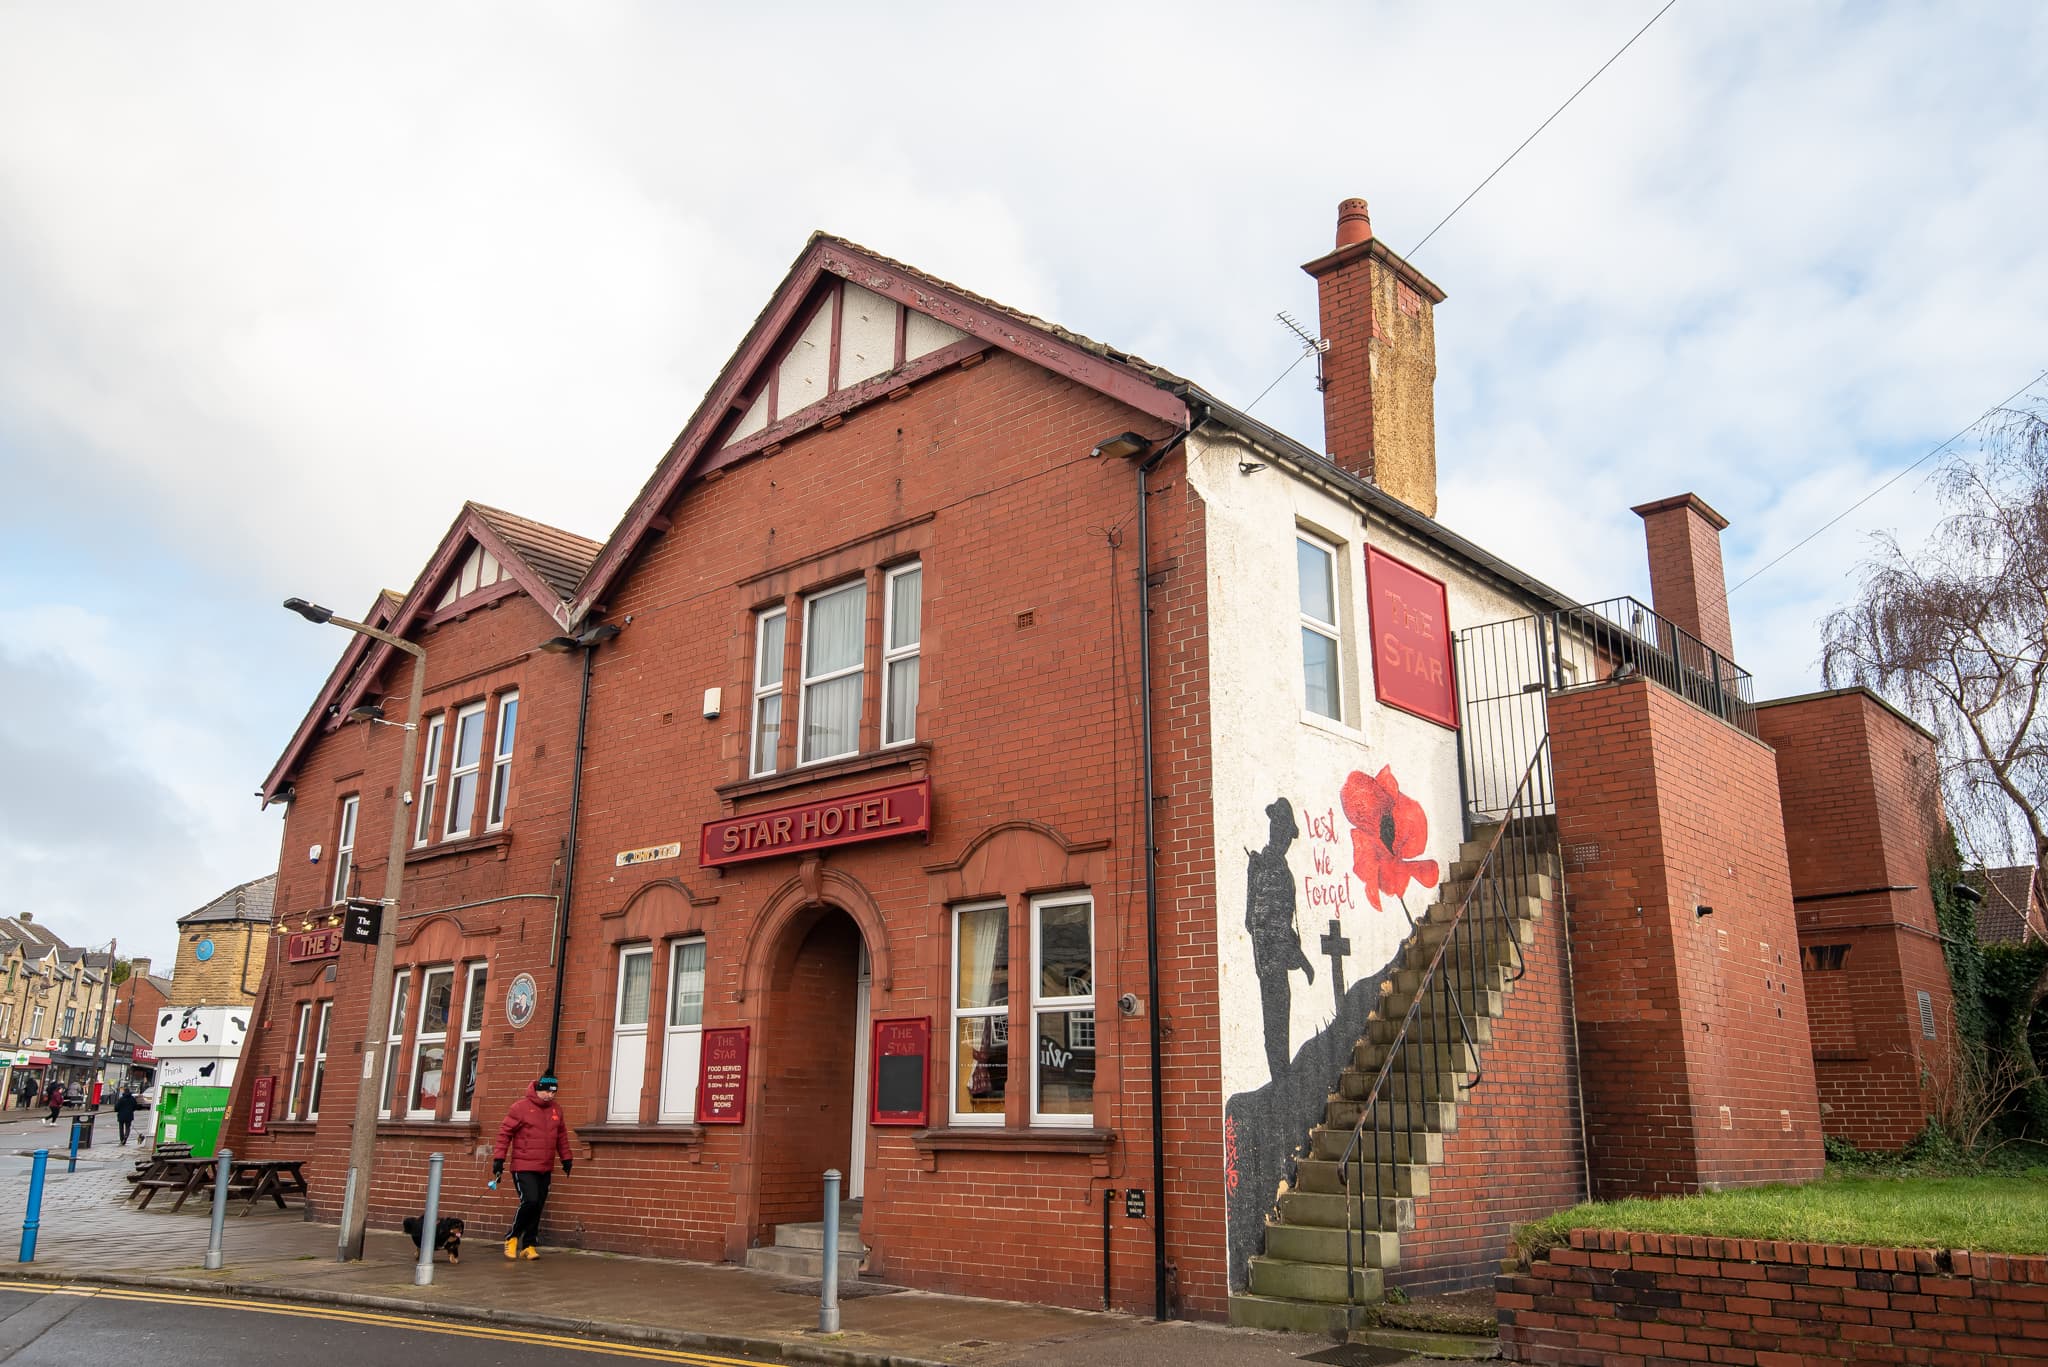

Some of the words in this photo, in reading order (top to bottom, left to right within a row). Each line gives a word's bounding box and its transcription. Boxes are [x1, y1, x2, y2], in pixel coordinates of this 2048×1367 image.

[1385, 589, 1434, 641] THE
[1383, 633, 1444, 687] STAR
[722, 816, 793, 853] STAR
[800, 797, 902, 840] HOTEL
[1303, 807, 1338, 845] Lest
[1313, 847, 1333, 876] We
[1304, 872, 1355, 919] Forget
[357, 916, 371, 926] The
[356, 927, 369, 936] Star
[301, 935, 326, 956] THE
[890, 1026, 913, 1039] THE
[717, 1036, 736, 1048] THE
[888, 1042, 916, 1054] STAR
[713, 1049, 737, 1060] STAR
[164, 1064, 183, 1077] Think
